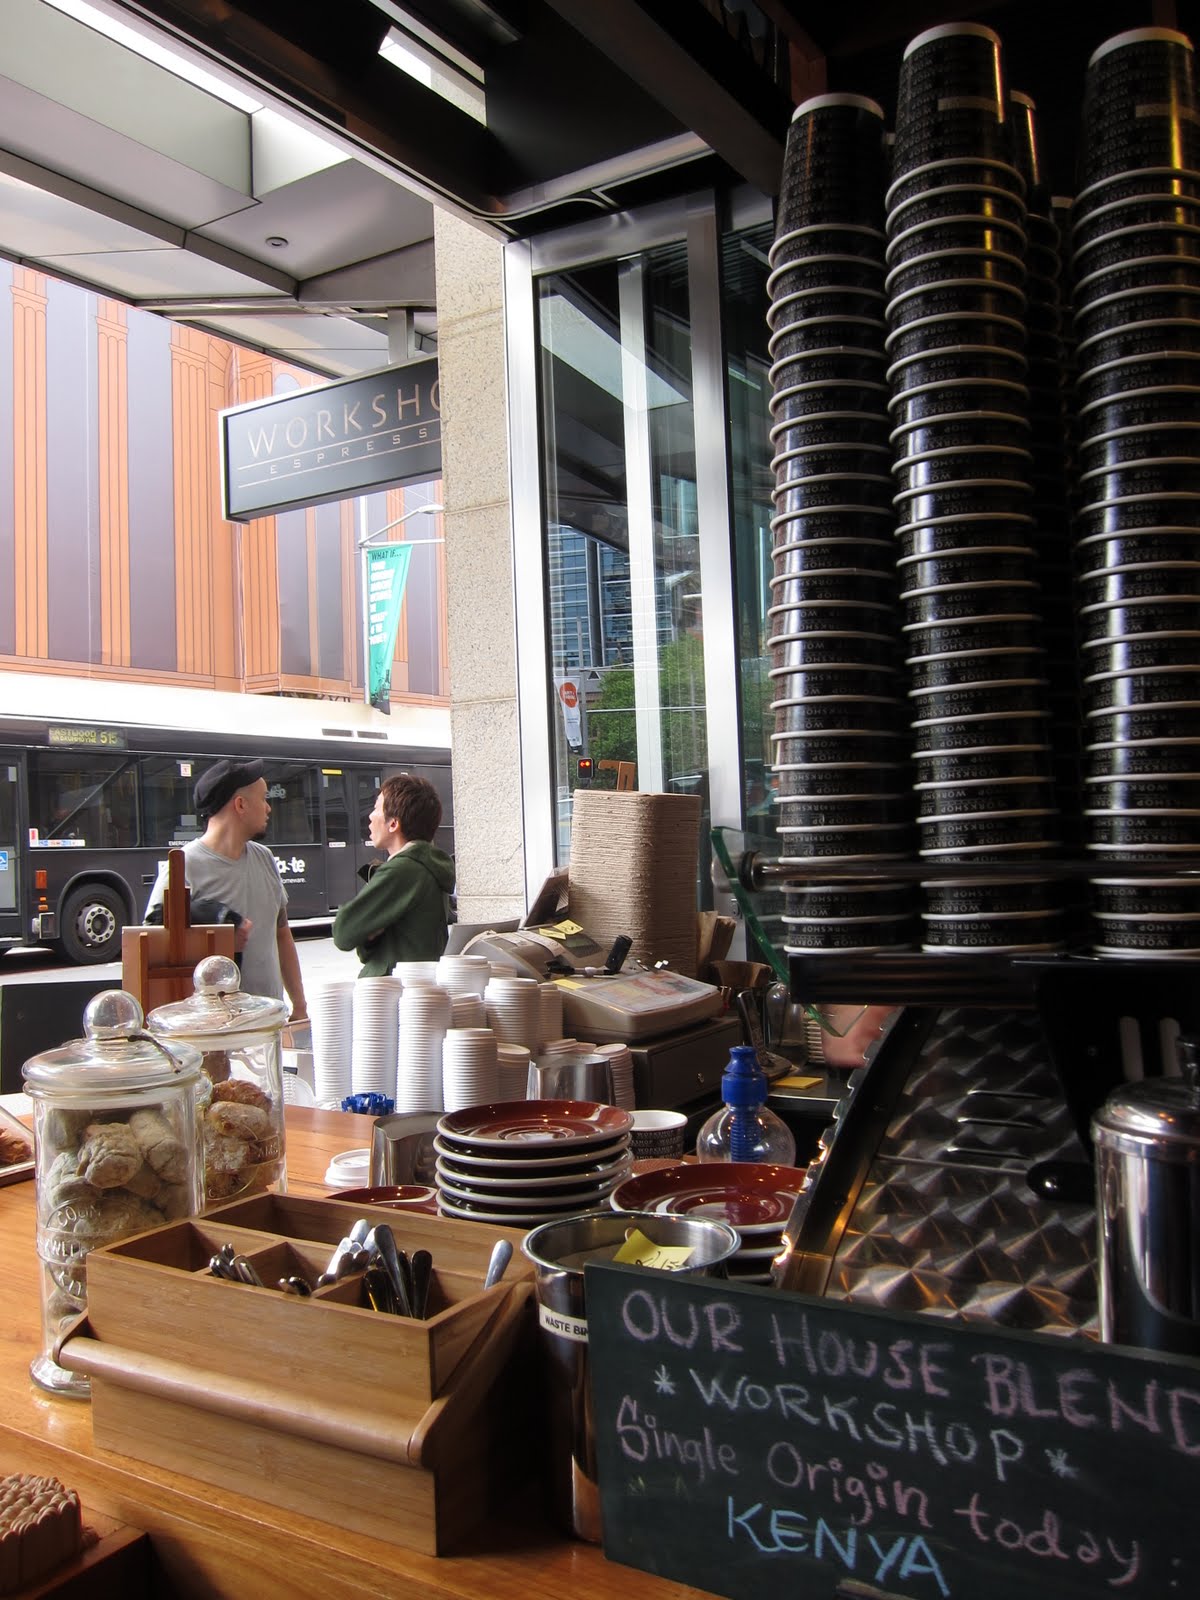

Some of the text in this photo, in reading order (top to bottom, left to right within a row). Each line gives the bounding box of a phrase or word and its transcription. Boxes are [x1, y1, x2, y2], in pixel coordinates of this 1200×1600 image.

[101, 730, 118, 745] 515
[545, 1315, 571, 1334] WASTE
[622, 1289, 1200, 1456] OUR HOUSE BLEND
[617, 1394, 1141, 1587] Single Origin today
[725, 1495, 951, 1598] KENYA
